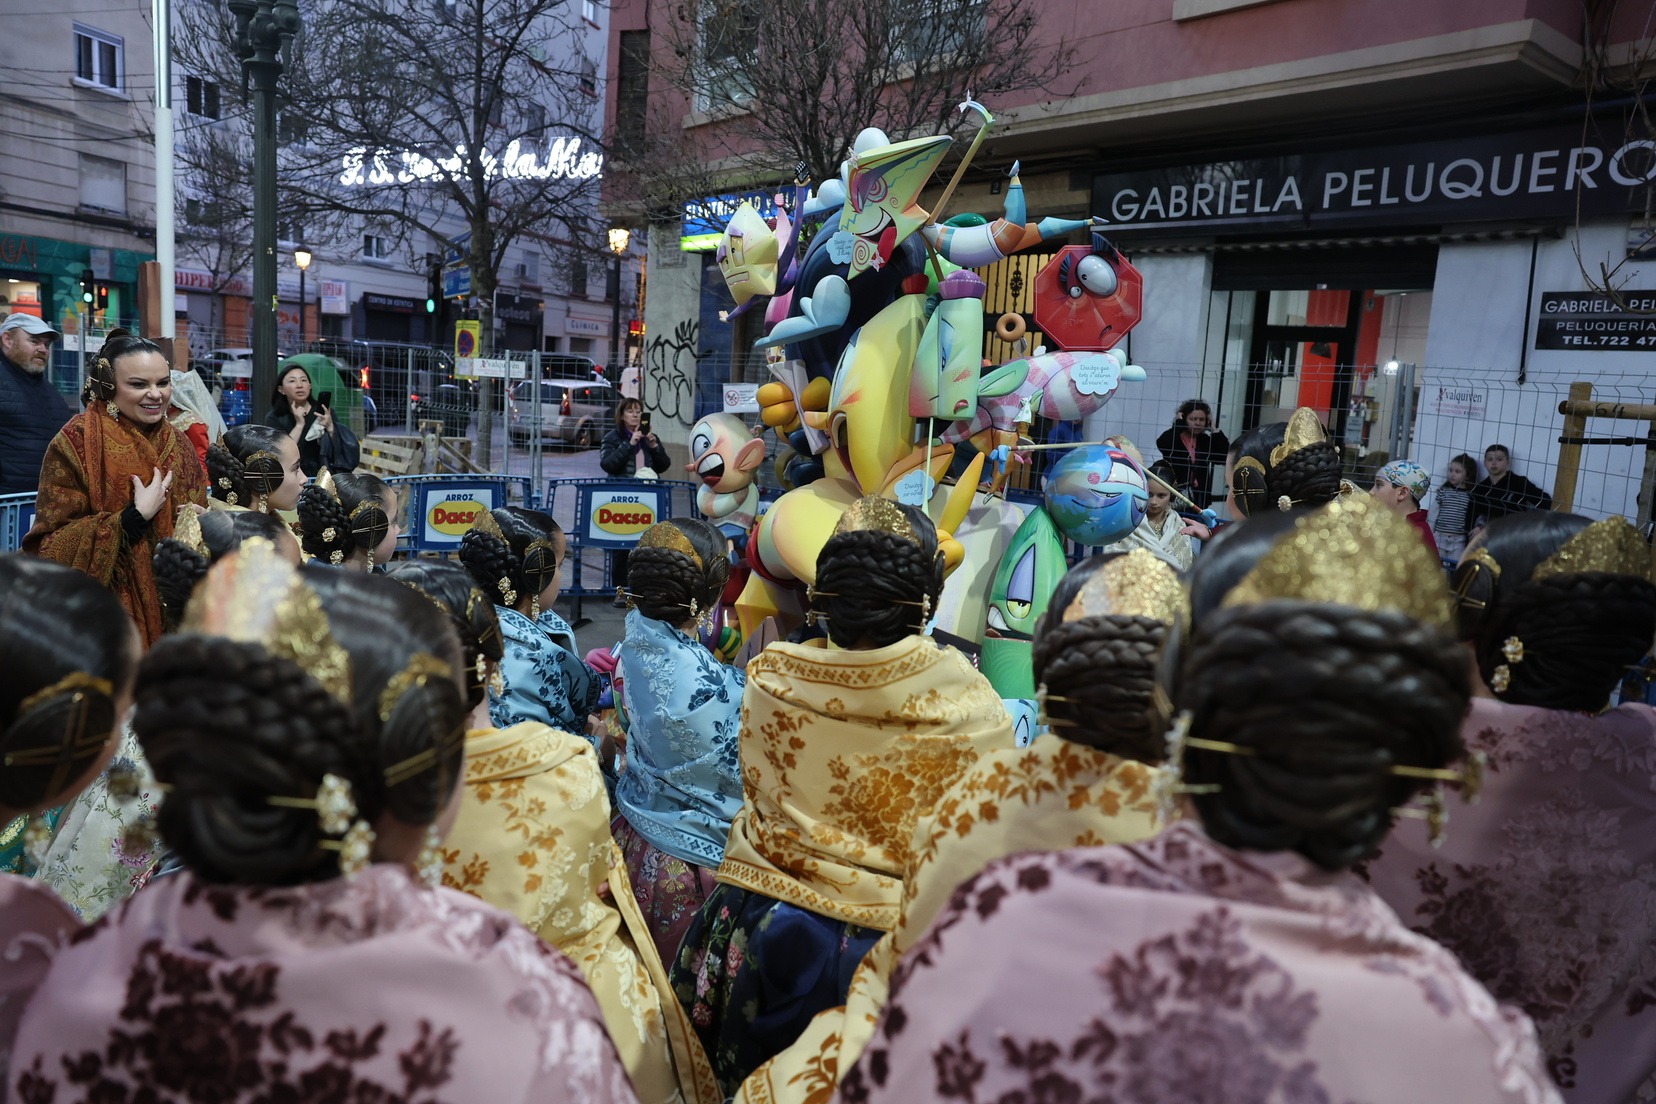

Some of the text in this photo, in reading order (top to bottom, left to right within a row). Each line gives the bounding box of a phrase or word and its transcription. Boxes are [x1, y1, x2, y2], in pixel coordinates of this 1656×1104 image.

[1111, 175, 1303, 222] GABRIELA
[1545, 300, 1623, 313] GABRIELA
[1556, 320, 1656, 331] PELUQUERÍA
[1562, 335, 1629, 346] TEL.722
[445, 493, 474, 501] ARROZ
[610, 495, 640, 503] ARROZ
[433, 508, 482, 525] Dacs
[598, 508, 652, 525] Dacsa
